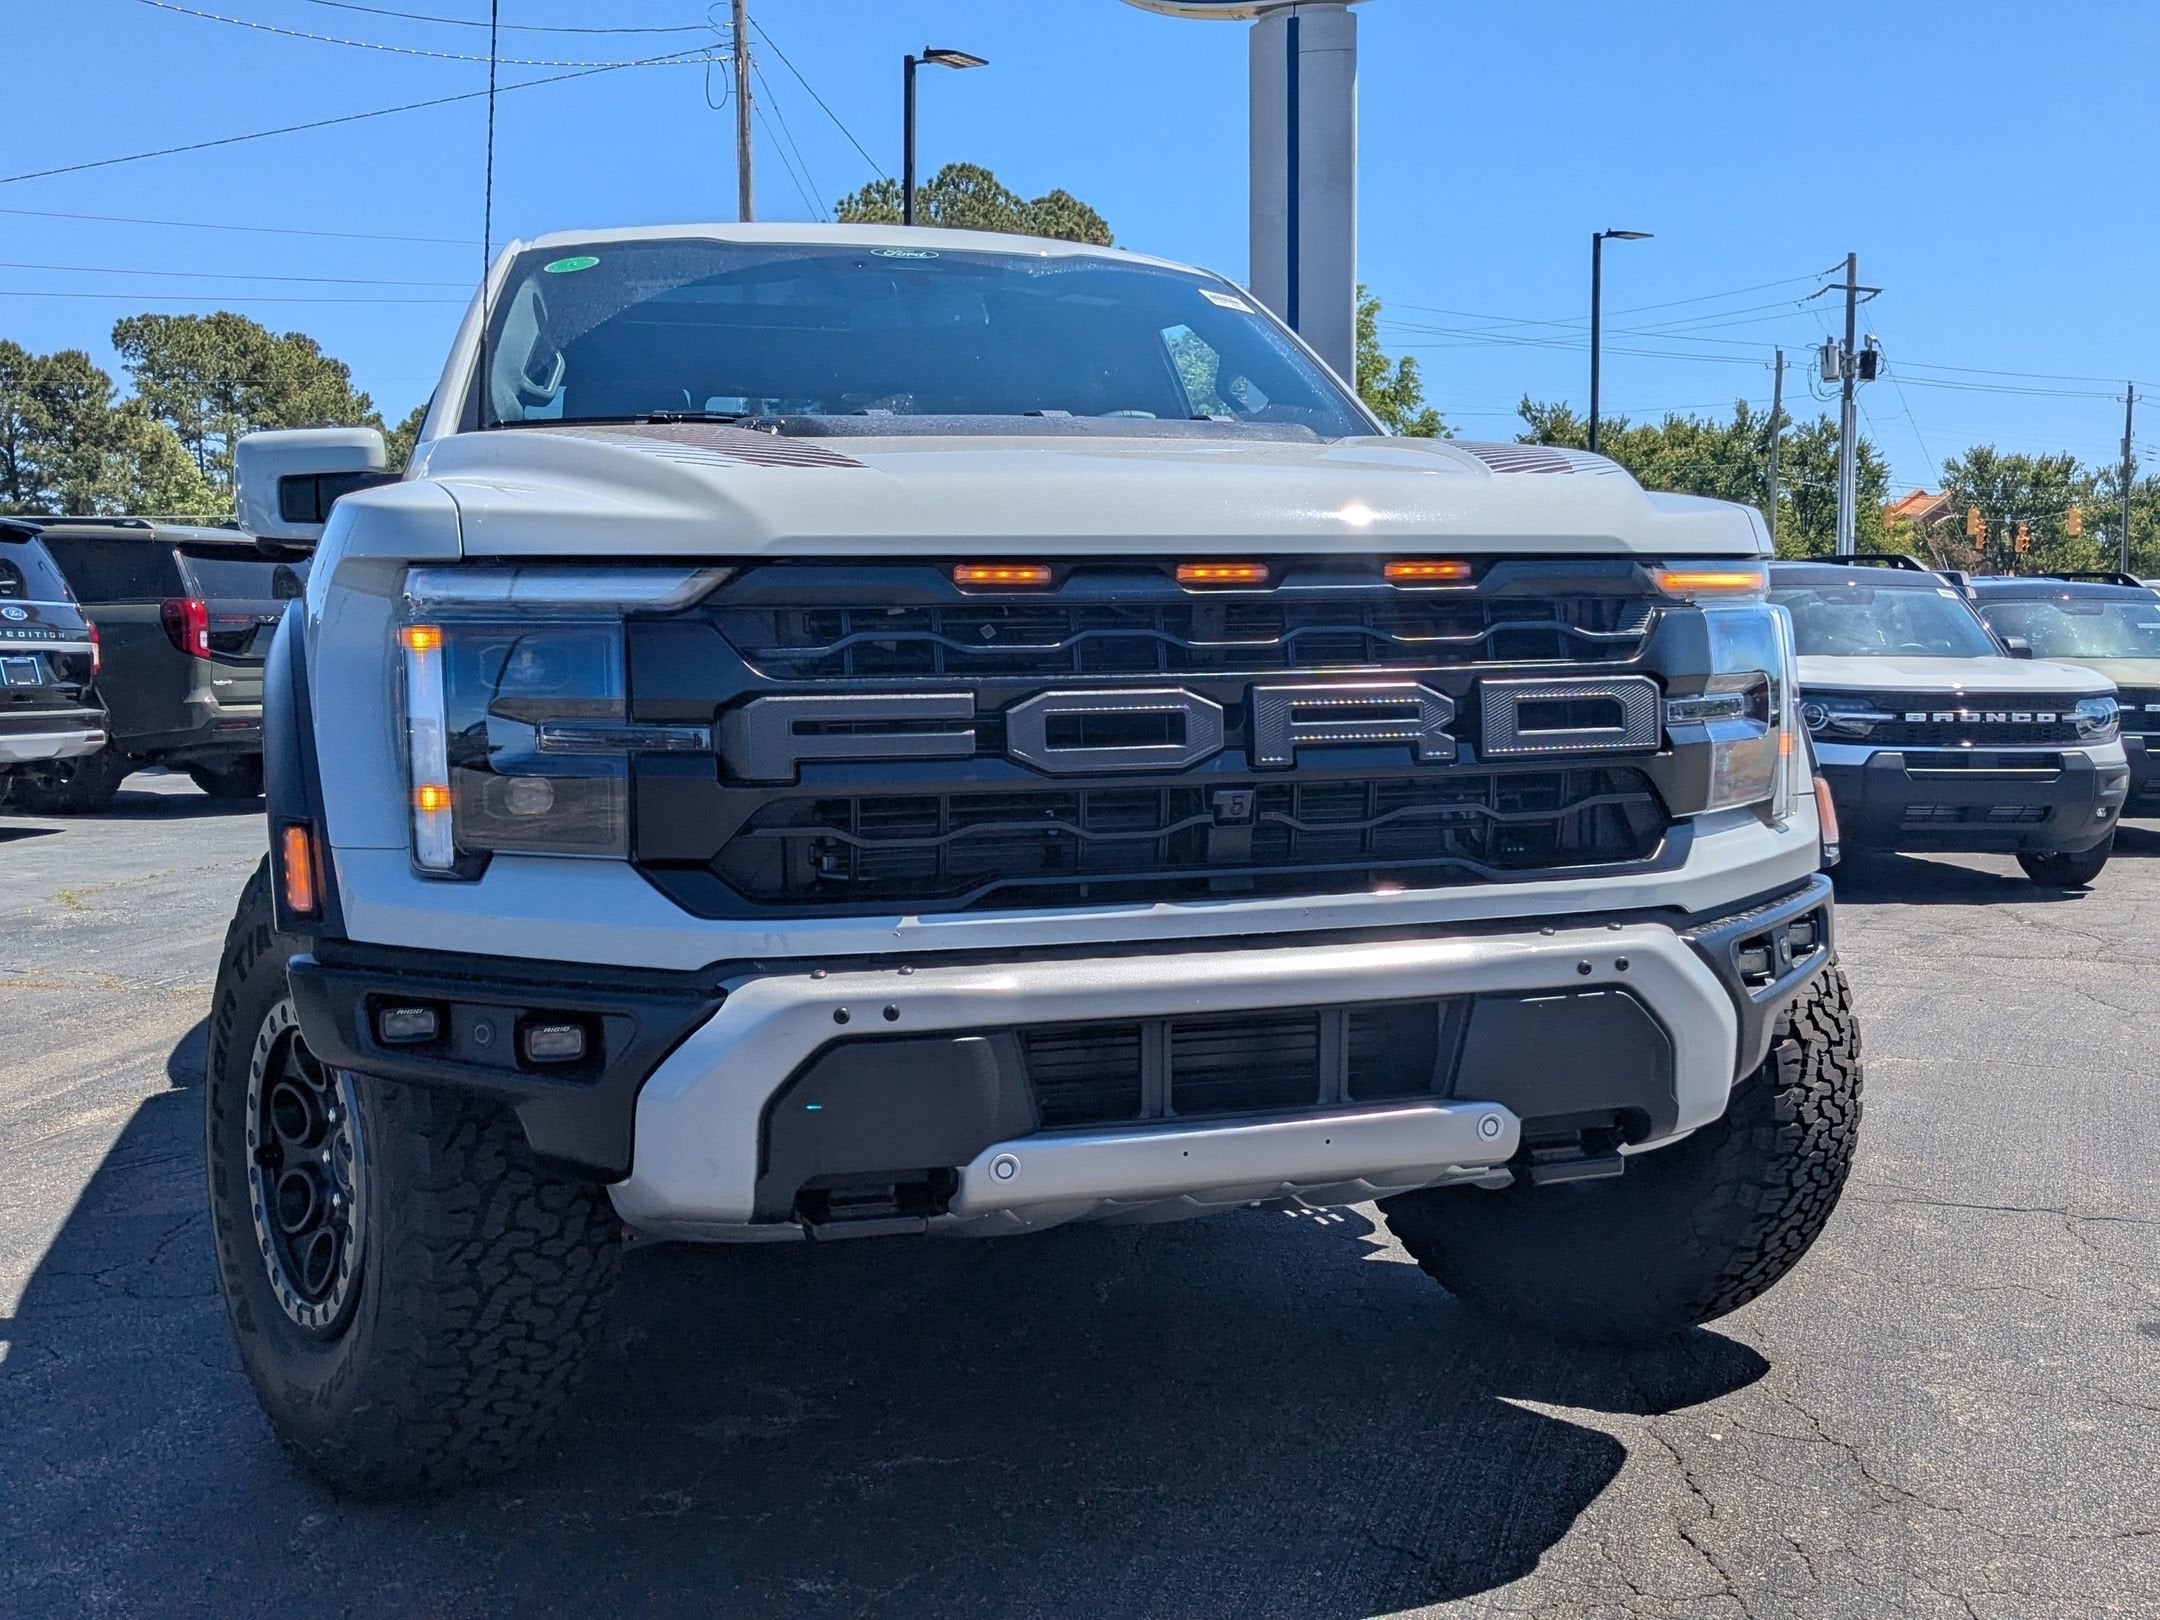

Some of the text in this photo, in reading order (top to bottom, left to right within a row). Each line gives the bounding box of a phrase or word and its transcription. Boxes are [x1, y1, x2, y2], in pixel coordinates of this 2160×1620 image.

[0, 630, 65, 638] EDITION
[1905, 713, 2056, 722] BRONCO
[718, 675, 1661, 780] FORD
